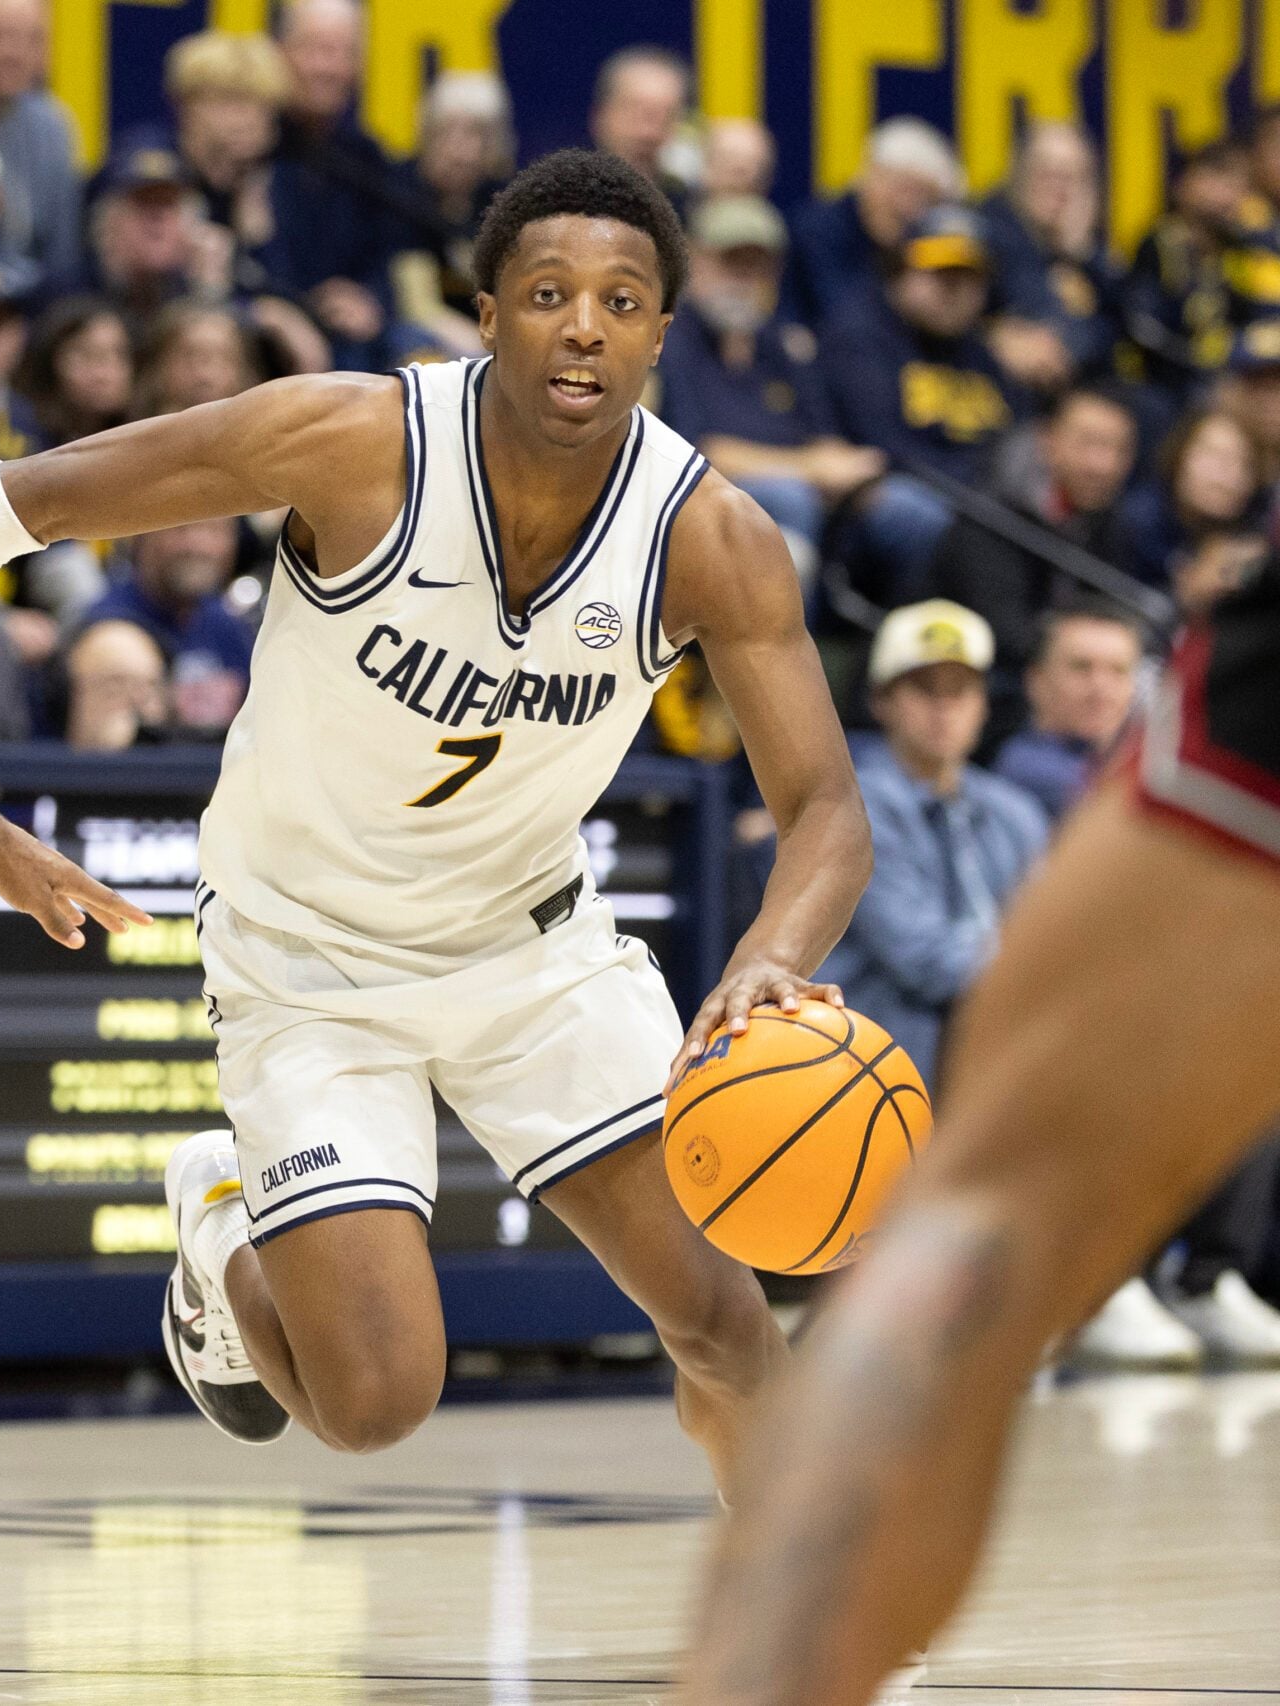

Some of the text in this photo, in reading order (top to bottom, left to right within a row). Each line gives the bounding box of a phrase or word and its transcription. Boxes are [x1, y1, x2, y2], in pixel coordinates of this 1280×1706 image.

[579, 616, 621, 631] ACC
[355, 623, 617, 728] CALIFORNIA
[402, 731, 504, 808] 7
[261, 1142, 342, 1194] CALIFORNIA
